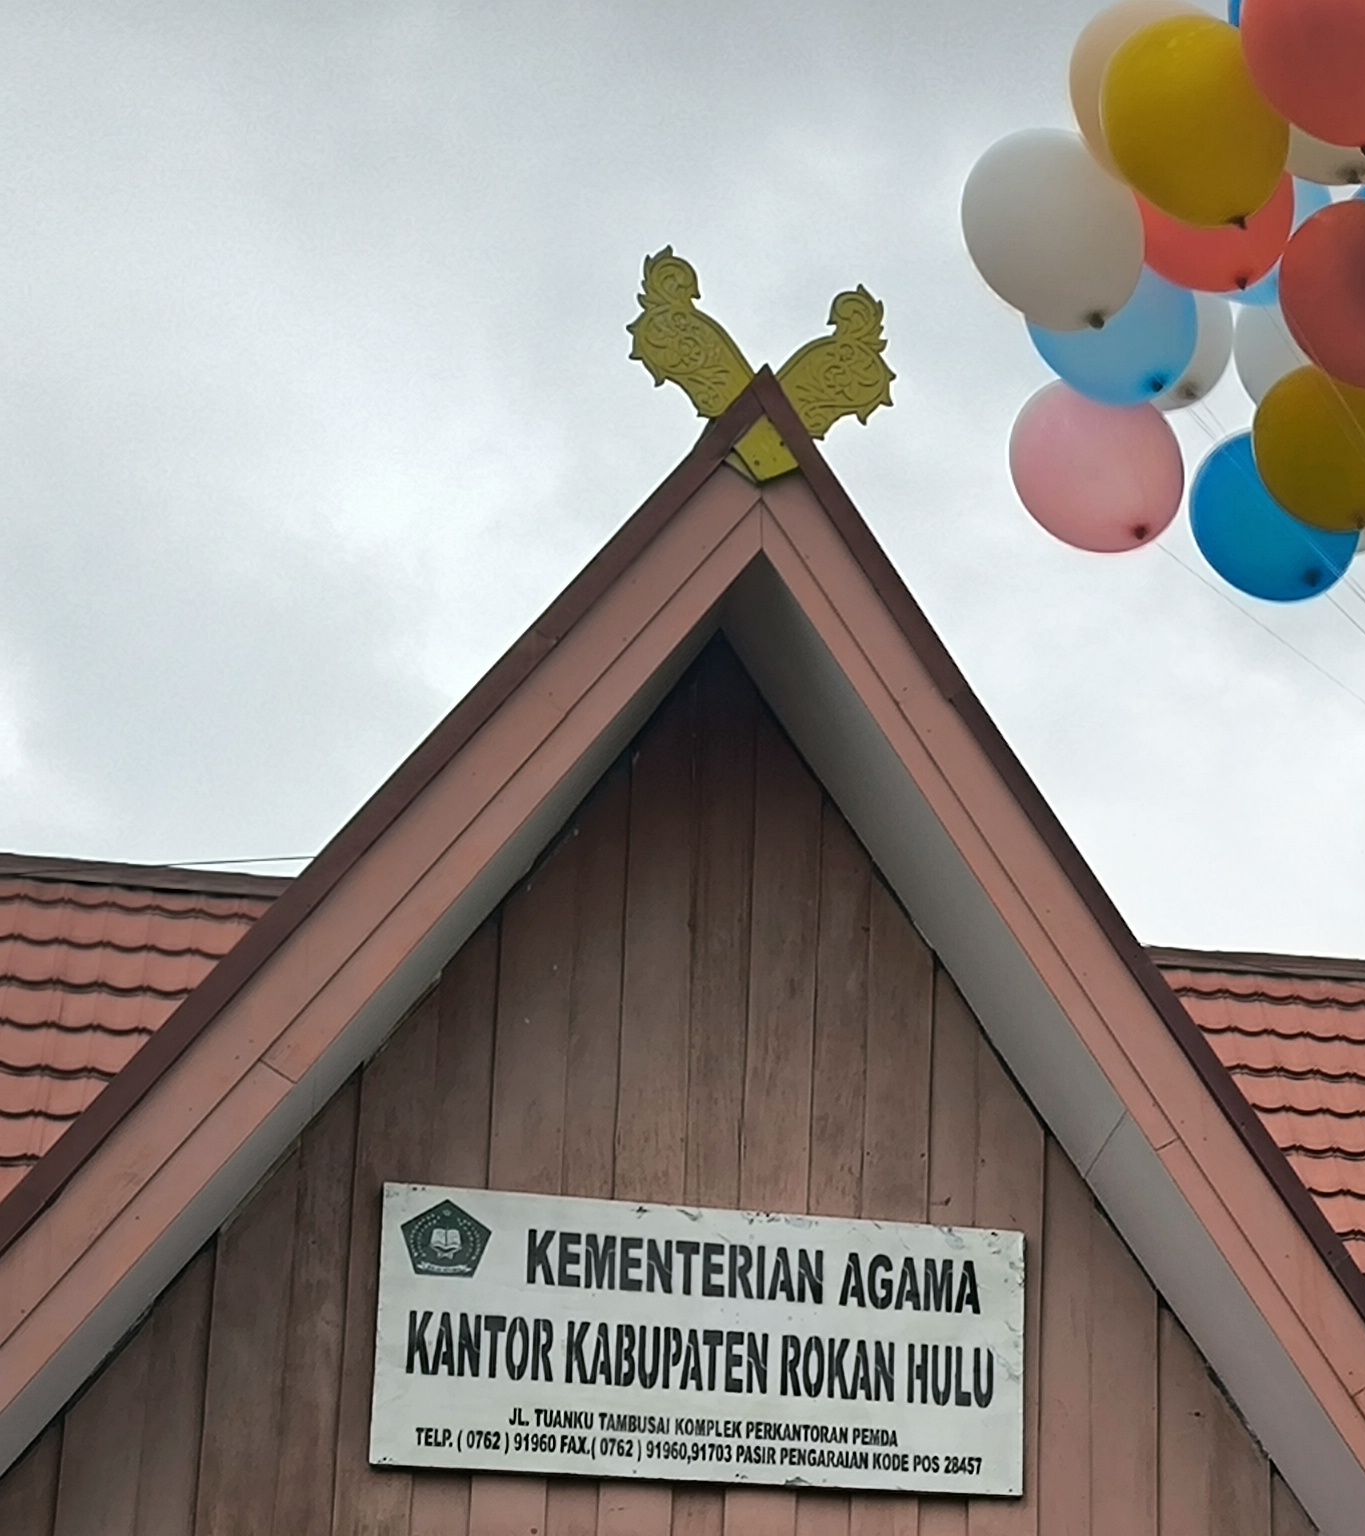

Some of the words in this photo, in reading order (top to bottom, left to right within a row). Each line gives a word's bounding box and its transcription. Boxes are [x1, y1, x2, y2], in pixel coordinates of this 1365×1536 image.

[527, 1228, 824, 1305] KEMENTERIAN
[839, 1252, 981, 1314] AGAMA
[405, 1310, 553, 1382] KANTOR
[565, 1320, 769, 1394] KABUPATEN
[780, 1335, 895, 1402] ROKAN
[907, 1343, 994, 1408] HULU
[415, 1426, 453, 1448] TELP.
[513, 1432, 557, 1453] 91960
[736, 1444, 777, 1465] PASIR
[780, 1447, 869, 1469] PENGARAIAN
[872, 1452, 910, 1472] KODE
[913, 1454, 940, 1473] POS
[943, 1455, 983, 1475] 28457
[509, 1407, 529, 1427] JL.
[534, 1408, 595, 1430] TUANKU
[598, 1412, 671, 1435] TAMBUSAI
[674, 1417, 743, 1439] KOMPLEK
[746, 1421, 849, 1444] PERKANTORAN
[852, 1427, 899, 1448] PEMDA
